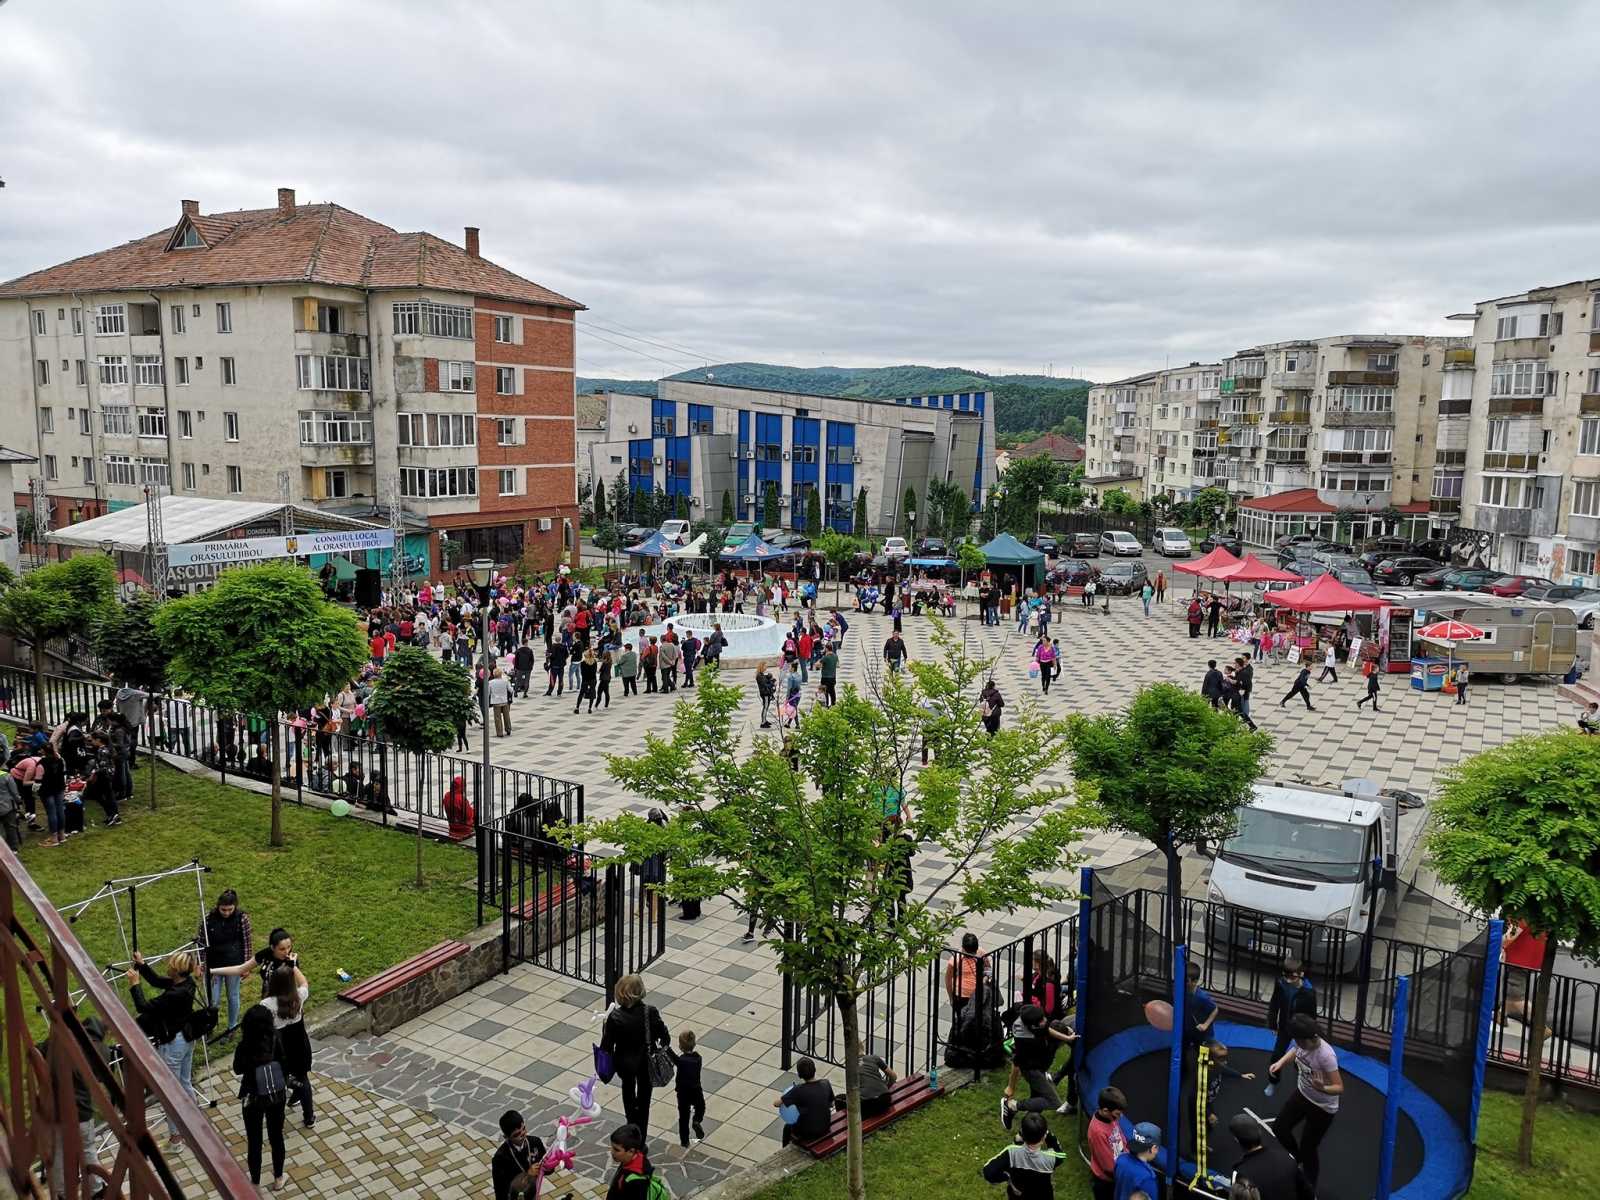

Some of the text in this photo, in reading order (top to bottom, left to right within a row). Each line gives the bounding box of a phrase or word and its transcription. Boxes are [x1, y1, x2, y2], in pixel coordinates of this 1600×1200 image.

[315, 532, 378, 543] CONSILIUL LOCAL
[360, 540, 382, 548] JIBOU
[238, 549, 263, 559] JIBOU
